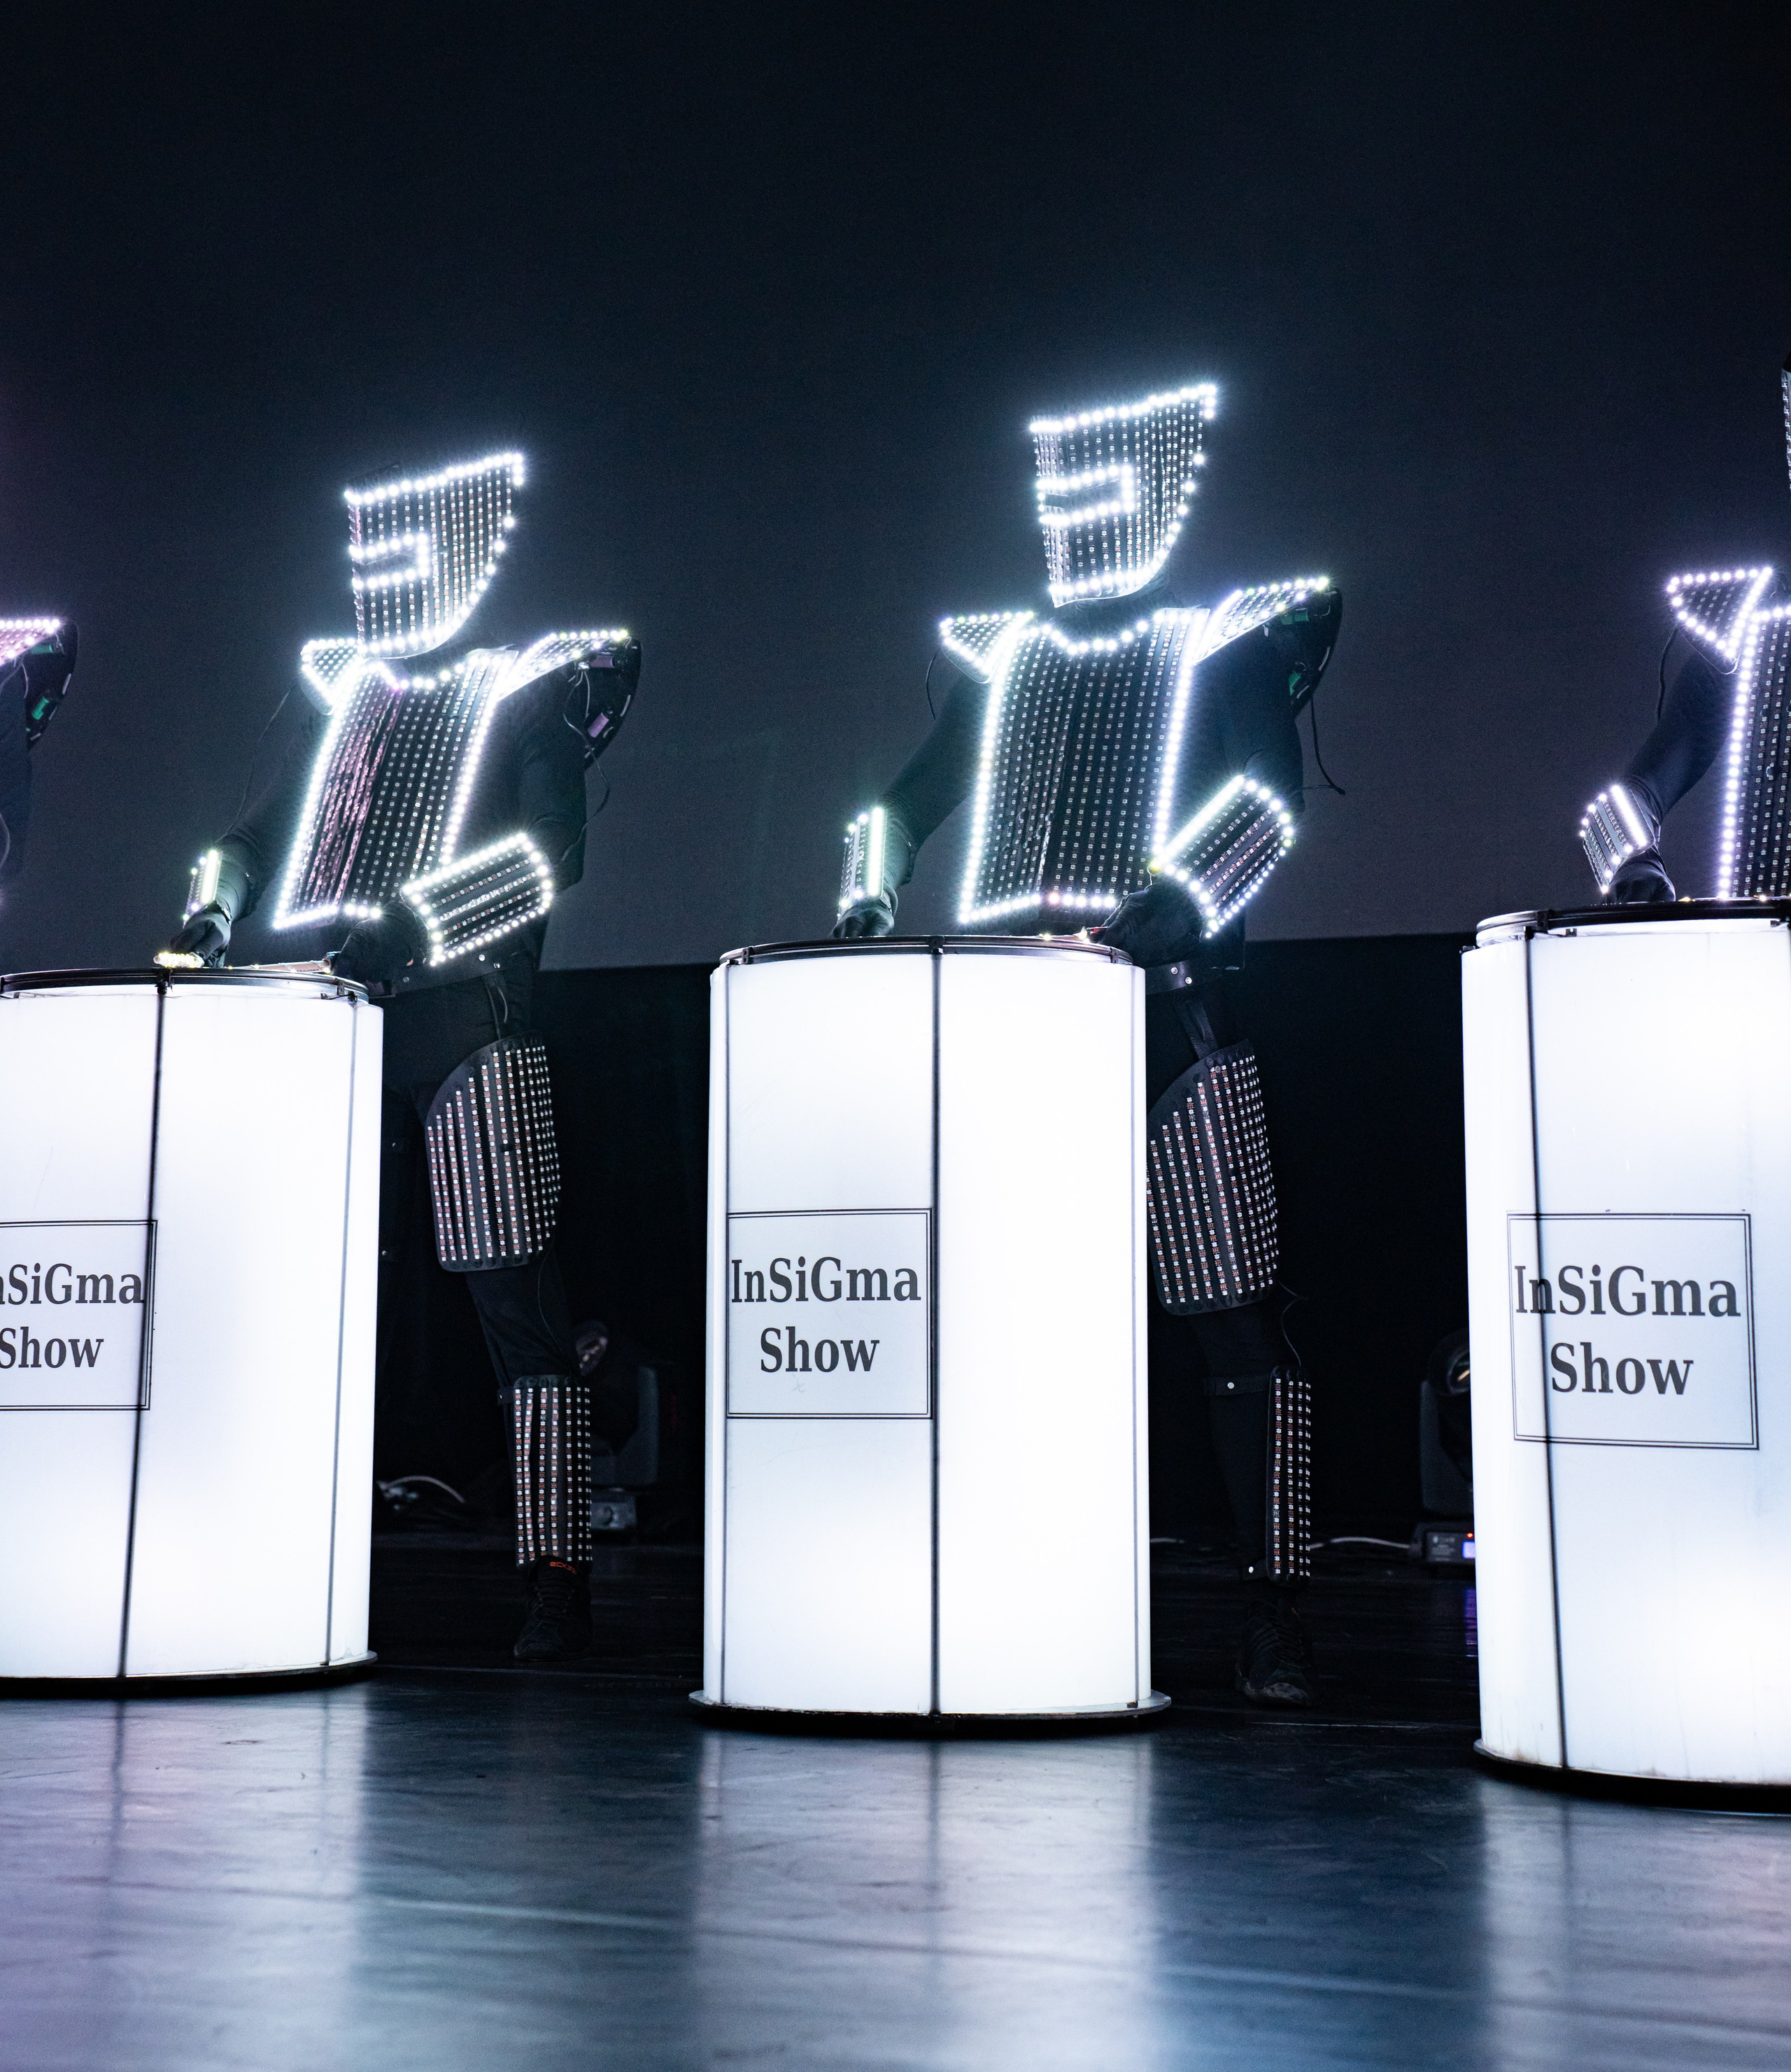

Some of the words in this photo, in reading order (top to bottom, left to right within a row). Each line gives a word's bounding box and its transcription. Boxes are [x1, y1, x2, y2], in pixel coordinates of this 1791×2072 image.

[0, 1263, 144, 1306] SiGma
[731, 1256, 921, 1303] InSiGma
[1515, 1264, 1741, 1317] InSiGma
[0, 1327, 104, 1369] Show
[760, 1326, 880, 1373] Show
[1550, 1342, 1694, 1395] Show
